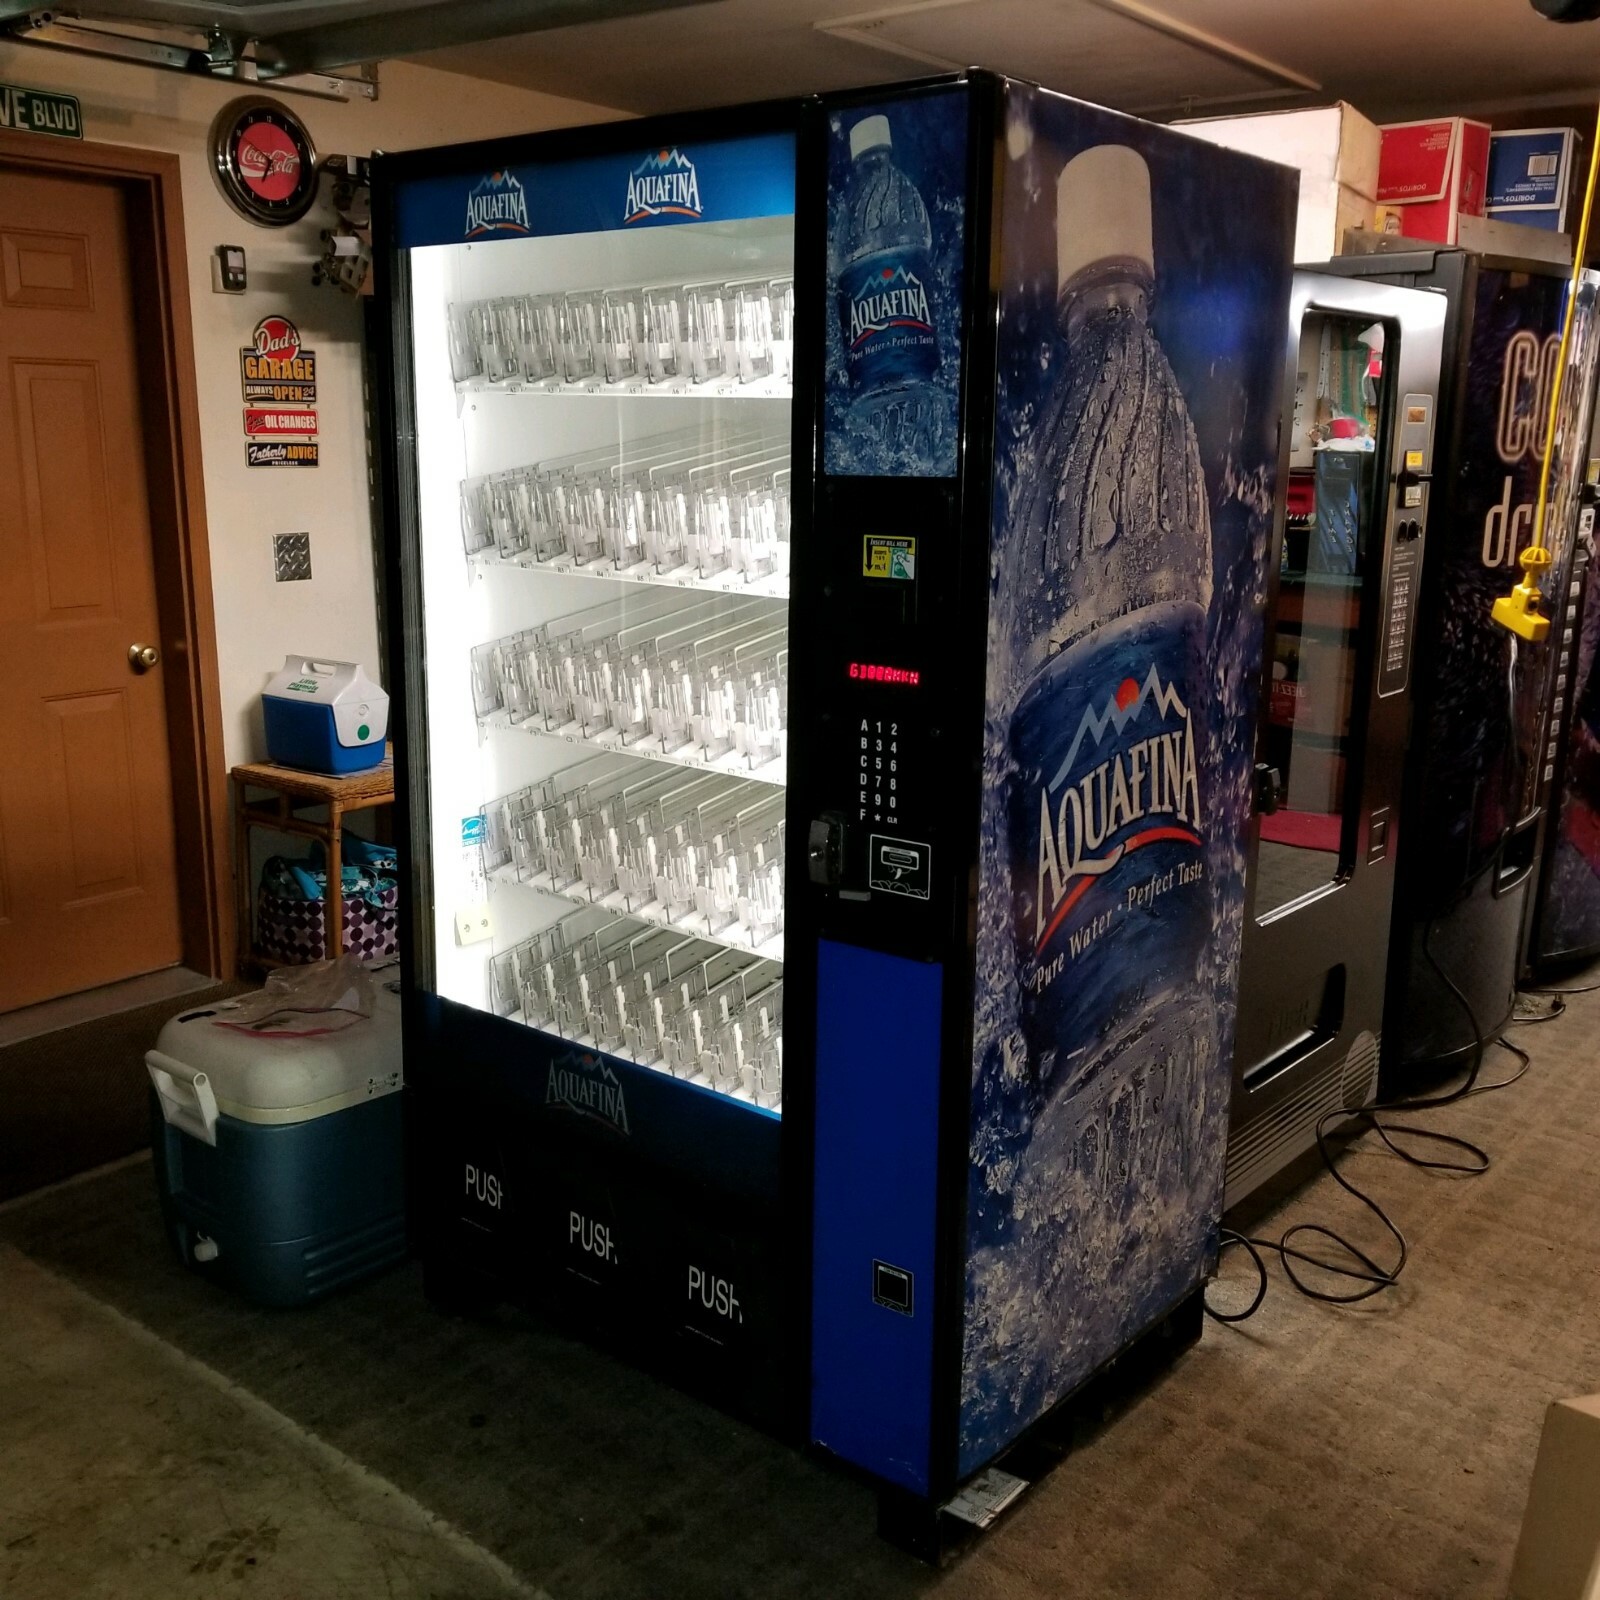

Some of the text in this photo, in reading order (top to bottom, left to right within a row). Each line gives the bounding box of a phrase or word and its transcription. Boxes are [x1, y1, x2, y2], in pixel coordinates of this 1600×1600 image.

[32, 99, 77, 131] BLVD
[624, 164, 702, 220] AQUAFINA
[1505, 194, 1536, 202] DORITOS
[465, 184, 530, 235] AQUAFINA
[850, 281, 932, 346] AQUAFINA
[254, 327, 300, 356] Dad's
[865, 342, 886, 355] Water
[892, 336, 917, 347] Perfect
[919, 335, 935, 345] Taste
[245, 357, 315, 380] GARAGE
[246, 385, 273, 395] ALWAYS
[273, 386, 302, 400] OPEN
[302, 387, 314, 396] 24
[264, 415, 278, 429] OIL
[278, 415, 316, 430] CHANGES
[249, 444, 317, 463] Fatherly ADVICE
[860, 719, 897, 735] A 1 2
[861, 737, 897, 754] B 3 4
[860, 755, 897, 772] C 5 6
[860, 773, 896, 790] D 7 8
[860, 791, 896, 808] E 9 0
[860, 809, 897, 824] F CLR
[1037, 707, 1201, 942] AQUAFINA
[1036, 861, 1203, 995] Pure Water Perfect Taste
[546, 1058, 630, 1136] AQUAFINA
[689, 1264, 743, 1324] PUSH
